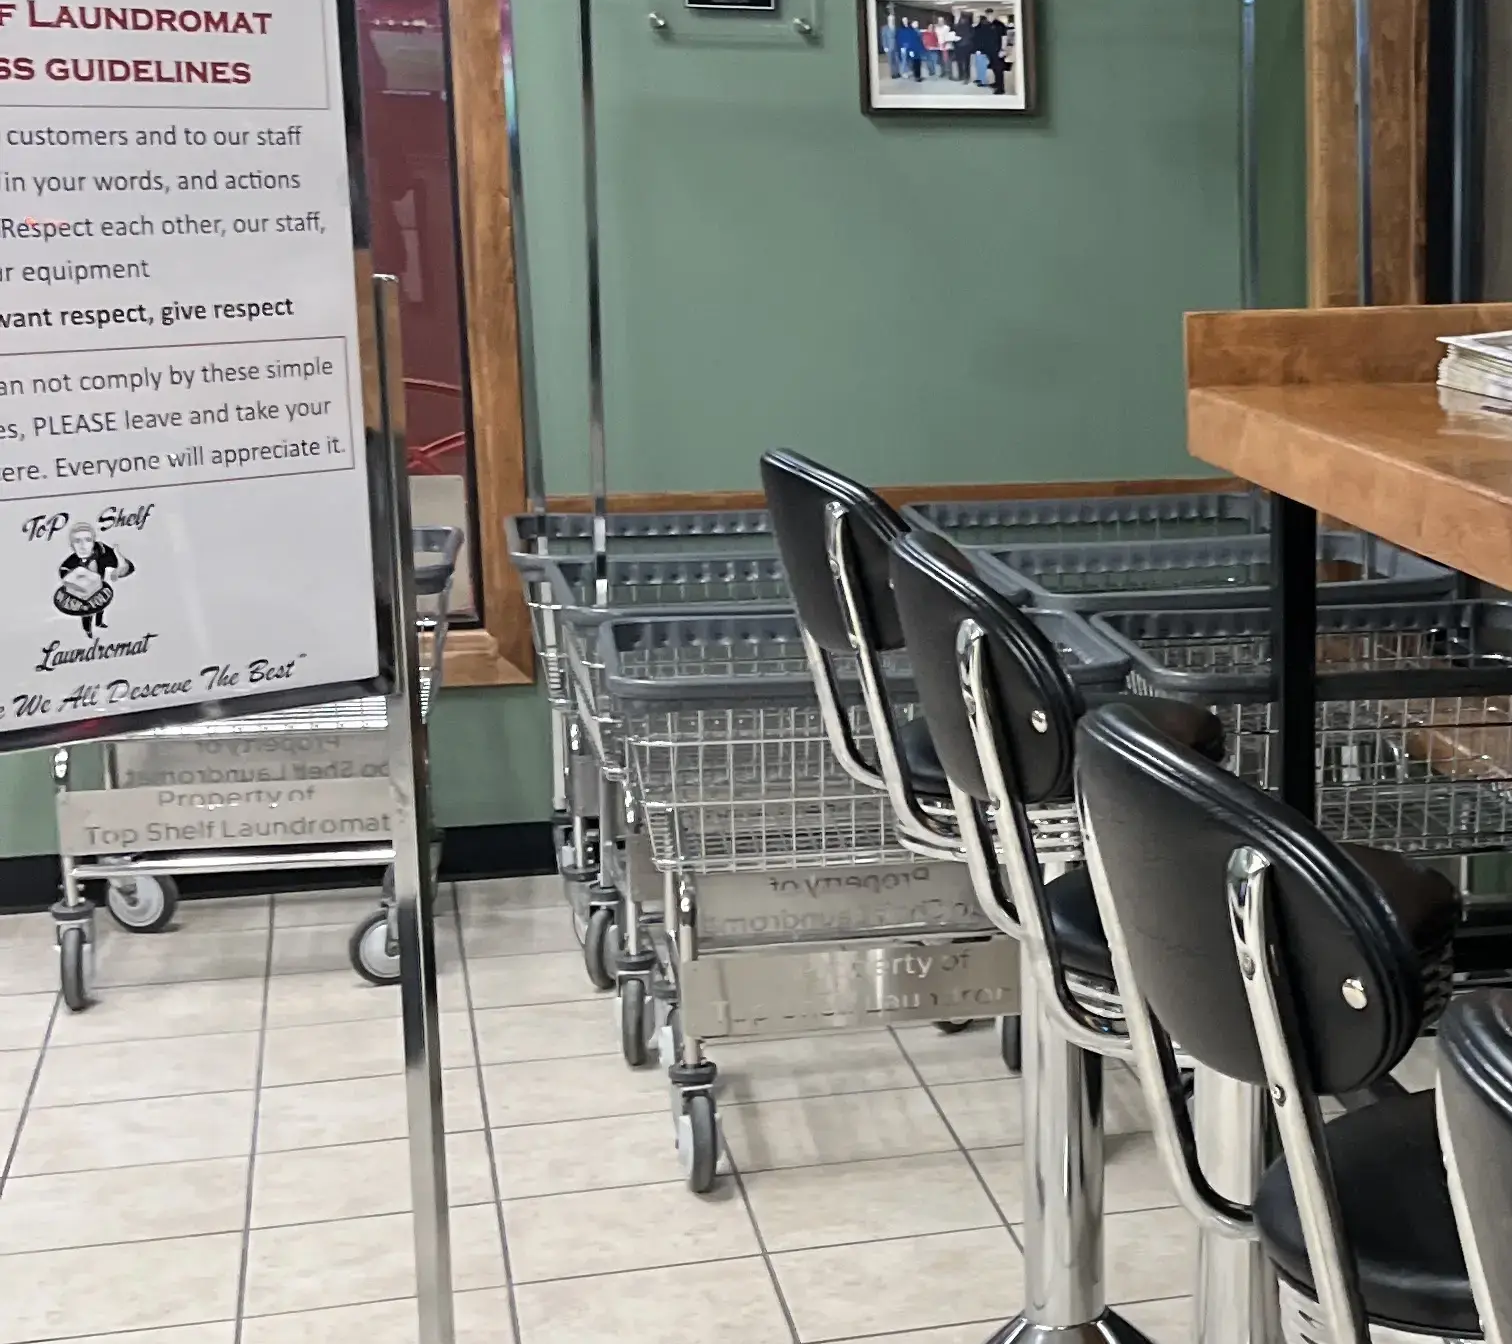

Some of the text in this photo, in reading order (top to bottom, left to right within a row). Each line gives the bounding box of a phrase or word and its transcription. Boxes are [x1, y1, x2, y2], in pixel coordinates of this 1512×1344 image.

[27, 0, 273, 35] LAUNDROMAT
[45, 58, 252, 84] GUIDELINES
[6, 124, 303, 146] customers and to our staff
[4, 168, 302, 197] in your words, and actions
[1, 210, 327, 243] Respect each other, our staff,
[22, 259, 151, 286] equipment
[59, 304, 155, 330] respect,
[161, 300, 208, 327] give
[213, 297, 295, 322] respect
[32, 373, 73, 395] not
[79, 366, 163, 394] comply
[169, 364, 196, 390] by
[201, 362, 260, 384] these
[266, 356, 333, 381] simple
[33, 411, 119, 438] PLEASE
[124, 409, 183, 431] leave
[189, 403, 230, 426] and
[236, 400, 280, 423] take
[285, 399, 332, 424] your
[55, 453, 161, 479] Everyone
[167, 445, 204, 468] will
[211, 438, 321, 469] appreciate
[326, 435, 346, 454] it.
[97, 502, 156, 532] Shelf
[35, 632, 160, 672] Laundromat
[106, 676, 193, 704] Deserve
[200, 662, 241, 692] The
[85, 812, 393, 849] Top Shelf Laundromat
